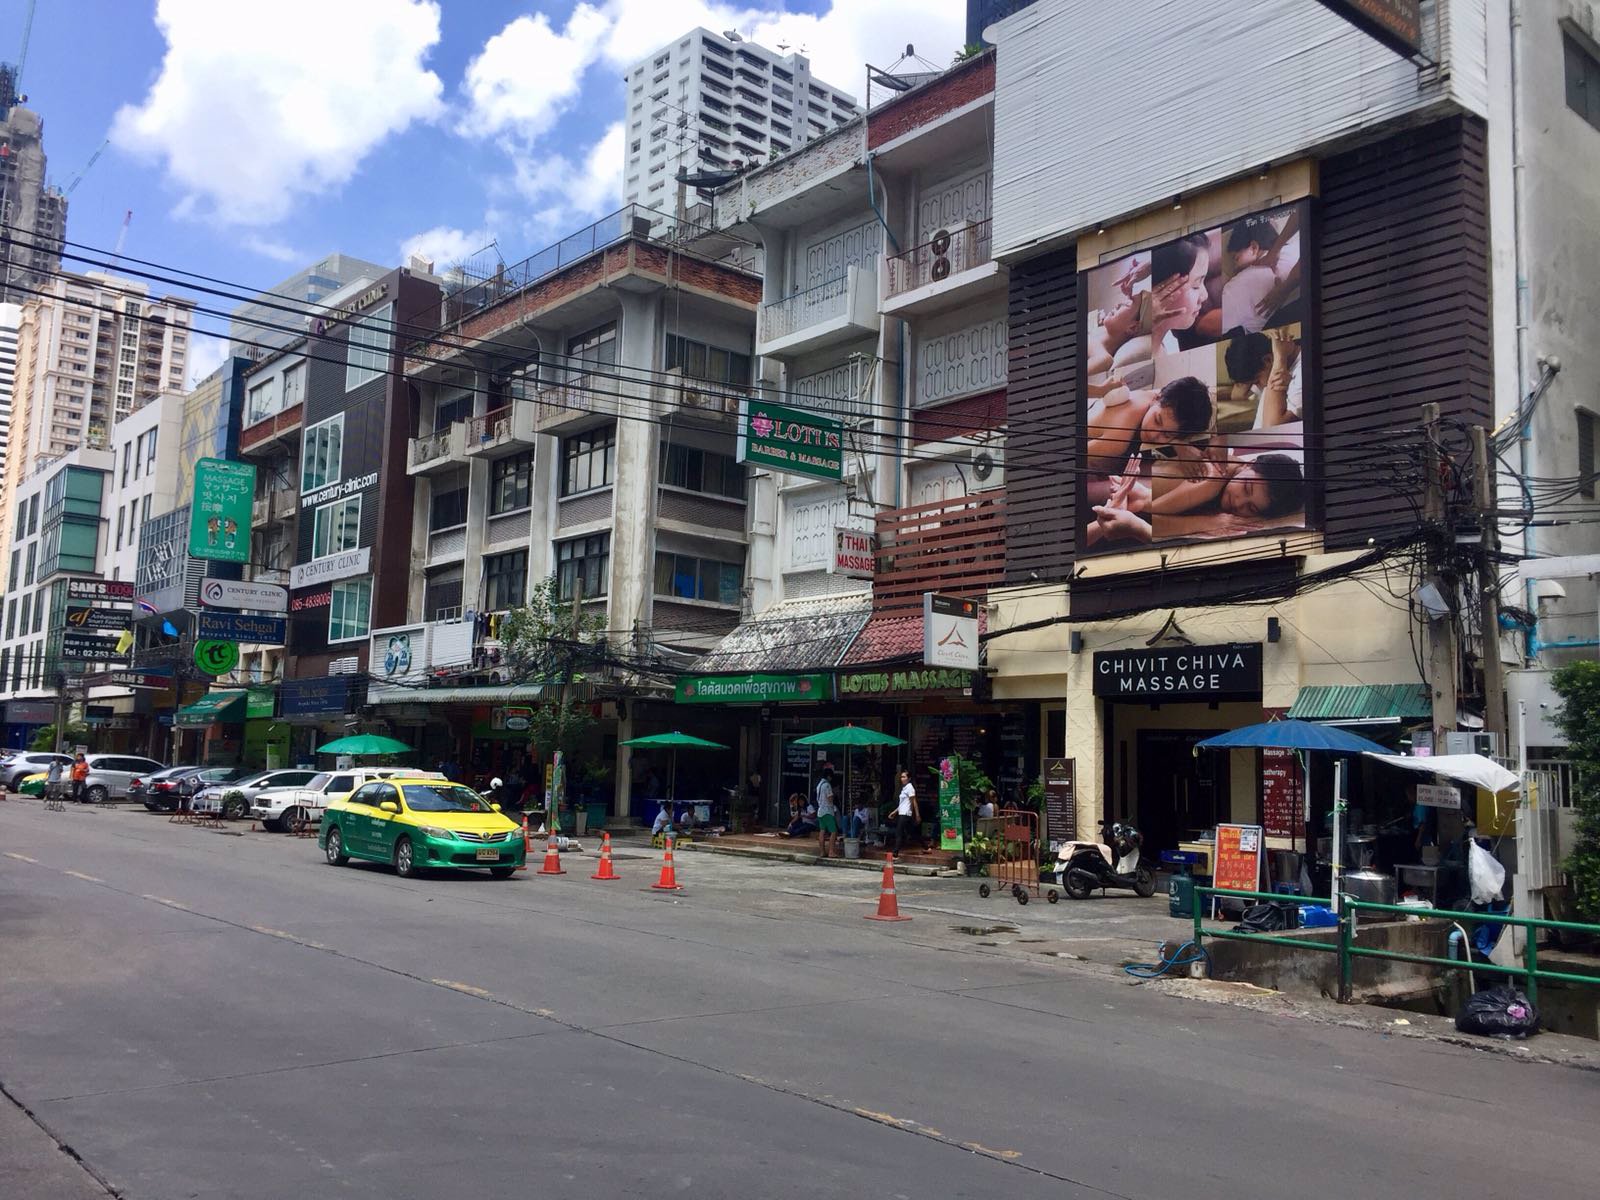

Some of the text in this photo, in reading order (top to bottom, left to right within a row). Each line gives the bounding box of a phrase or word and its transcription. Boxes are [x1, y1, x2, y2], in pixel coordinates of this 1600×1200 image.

[774, 420, 840, 448] LOTUS
[751, 442, 788, 459] BARBER
[798, 453, 840, 470] MASSAGE
[203, 474, 246, 486] MASSAGE
[203, 481, 249, 495] マッサージ
[302, 472, 378, 508] www.century-clinic.com
[845, 535, 868, 552] THAI
[305, 553, 361, 577] CENTURY CLINIC
[837, 553, 875, 571] MASSAGE
[70, 581, 106, 594] SAM'S
[227, 586, 283, 598] CENTURY CLINIC
[201, 616, 277, 635] Ravi Sehgal
[64, 648, 76, 656] Tel
[82, 649, 92, 657] 02
[1100, 653, 1245, 674] CHIVIT CHIVA
[841, 669, 972, 693] LOTUS MASSAGE
[1120, 674, 1220, 692] MASSAGE
